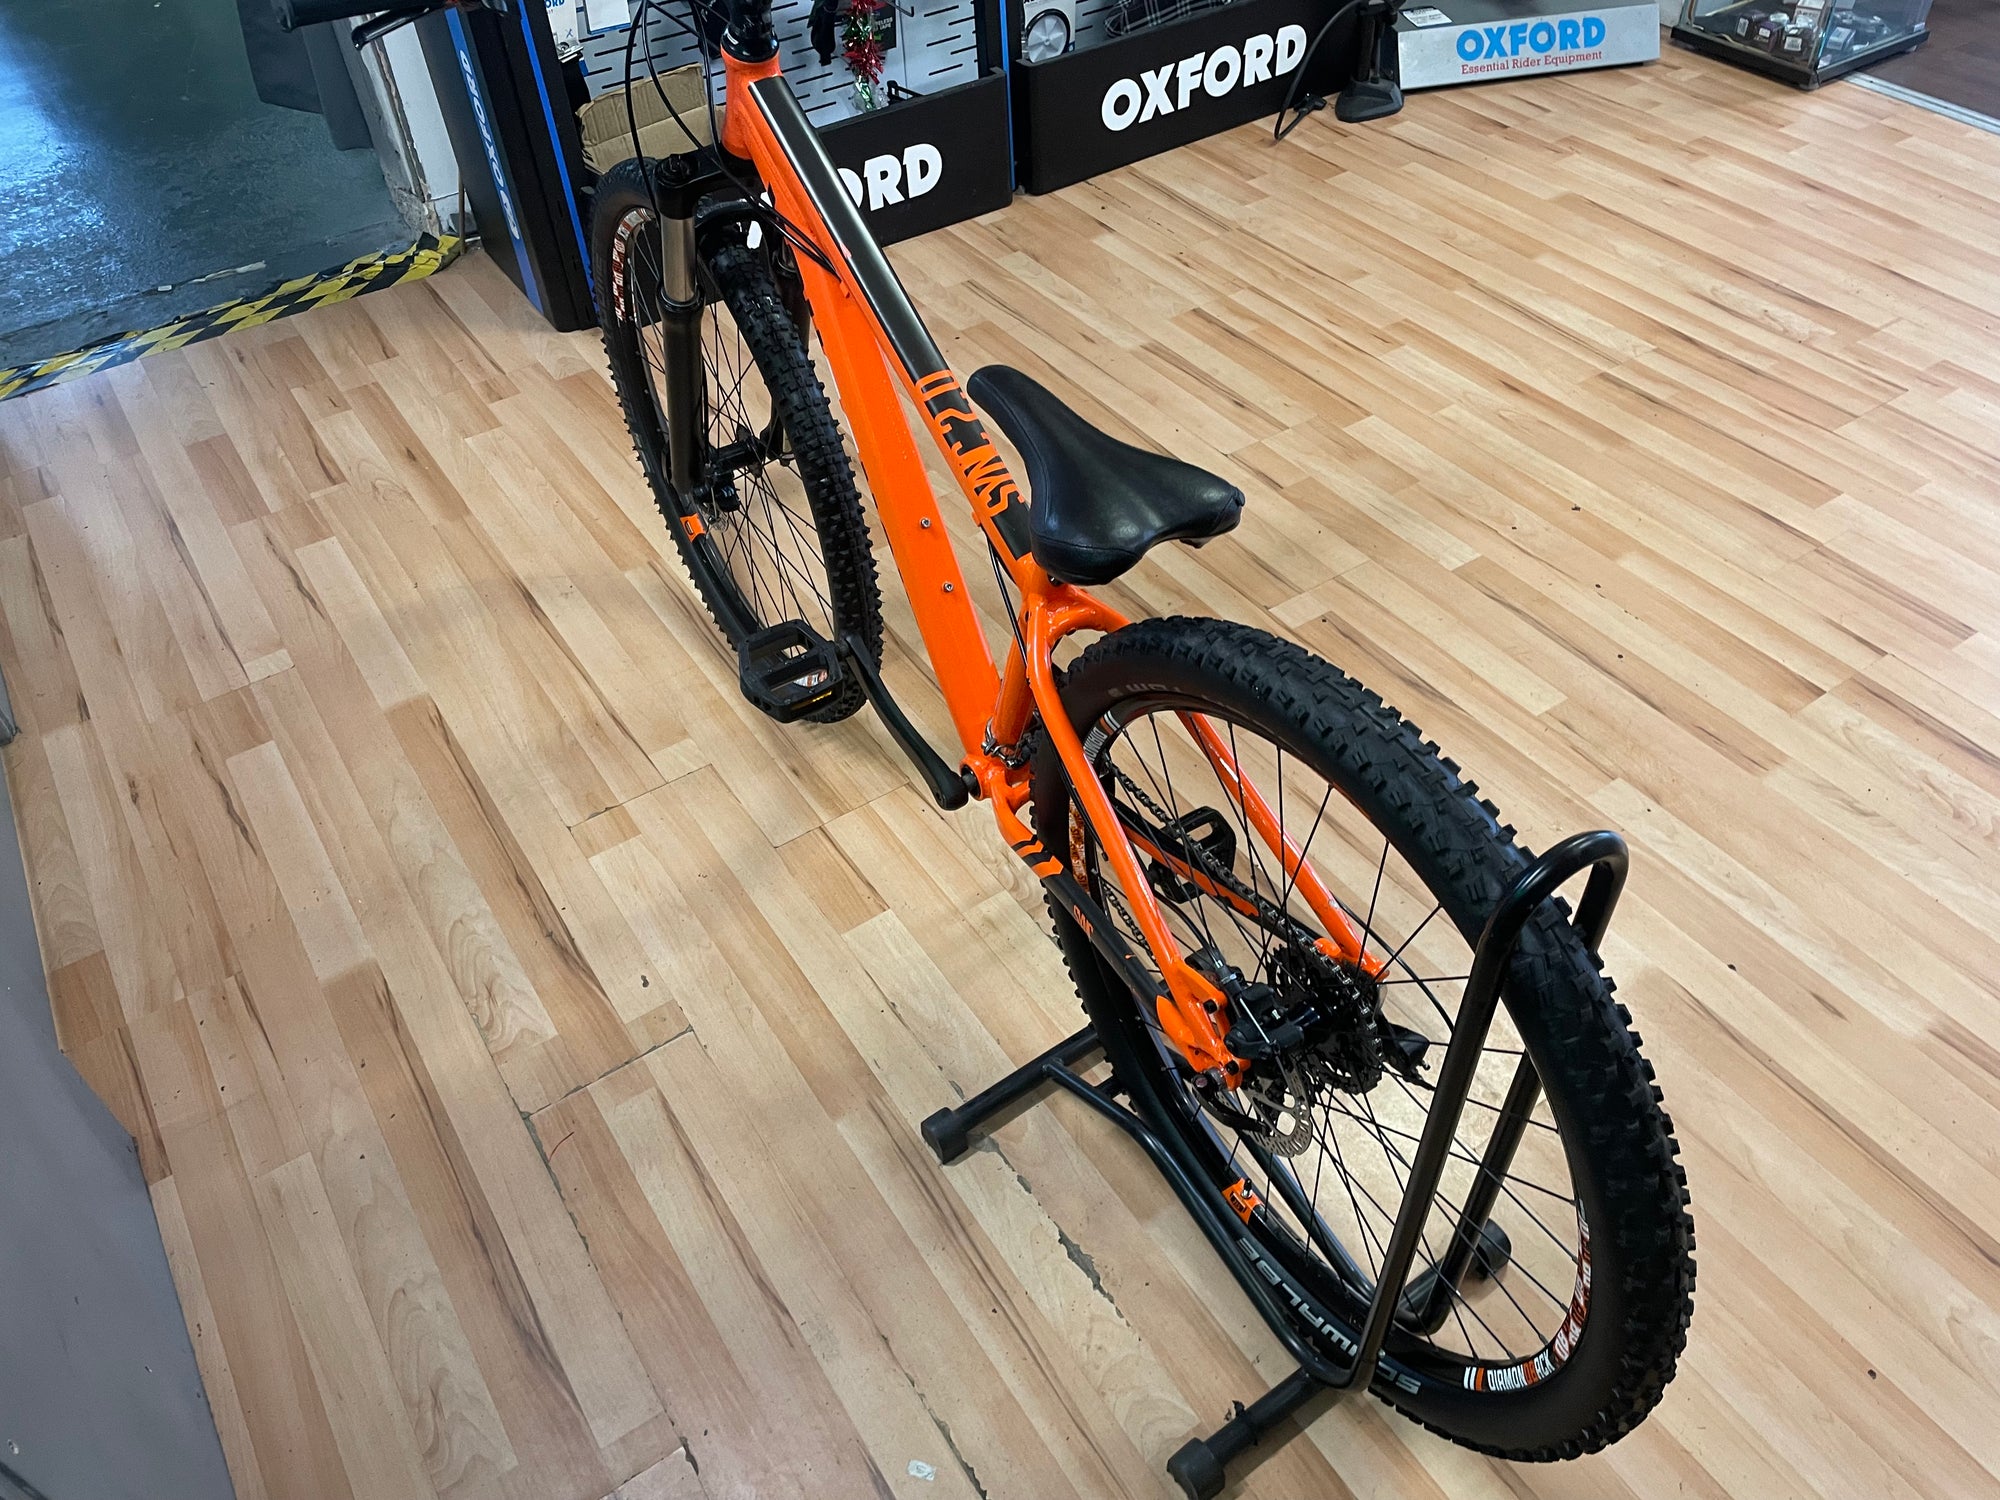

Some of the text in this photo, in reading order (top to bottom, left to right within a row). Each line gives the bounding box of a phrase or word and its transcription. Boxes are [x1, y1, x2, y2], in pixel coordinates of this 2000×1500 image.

[1456, 17, 1606, 61] OXFORD
[1461, 51, 1603, 75] Essential Rider Equipment
[1101, 24, 1307, 131] OXFORD
[459, 49, 504, 188] OXFORD
[1236, 1237, 1422, 1395] SCWALBE
[1486, 1348, 1556, 1392] DIAMONDBACK
